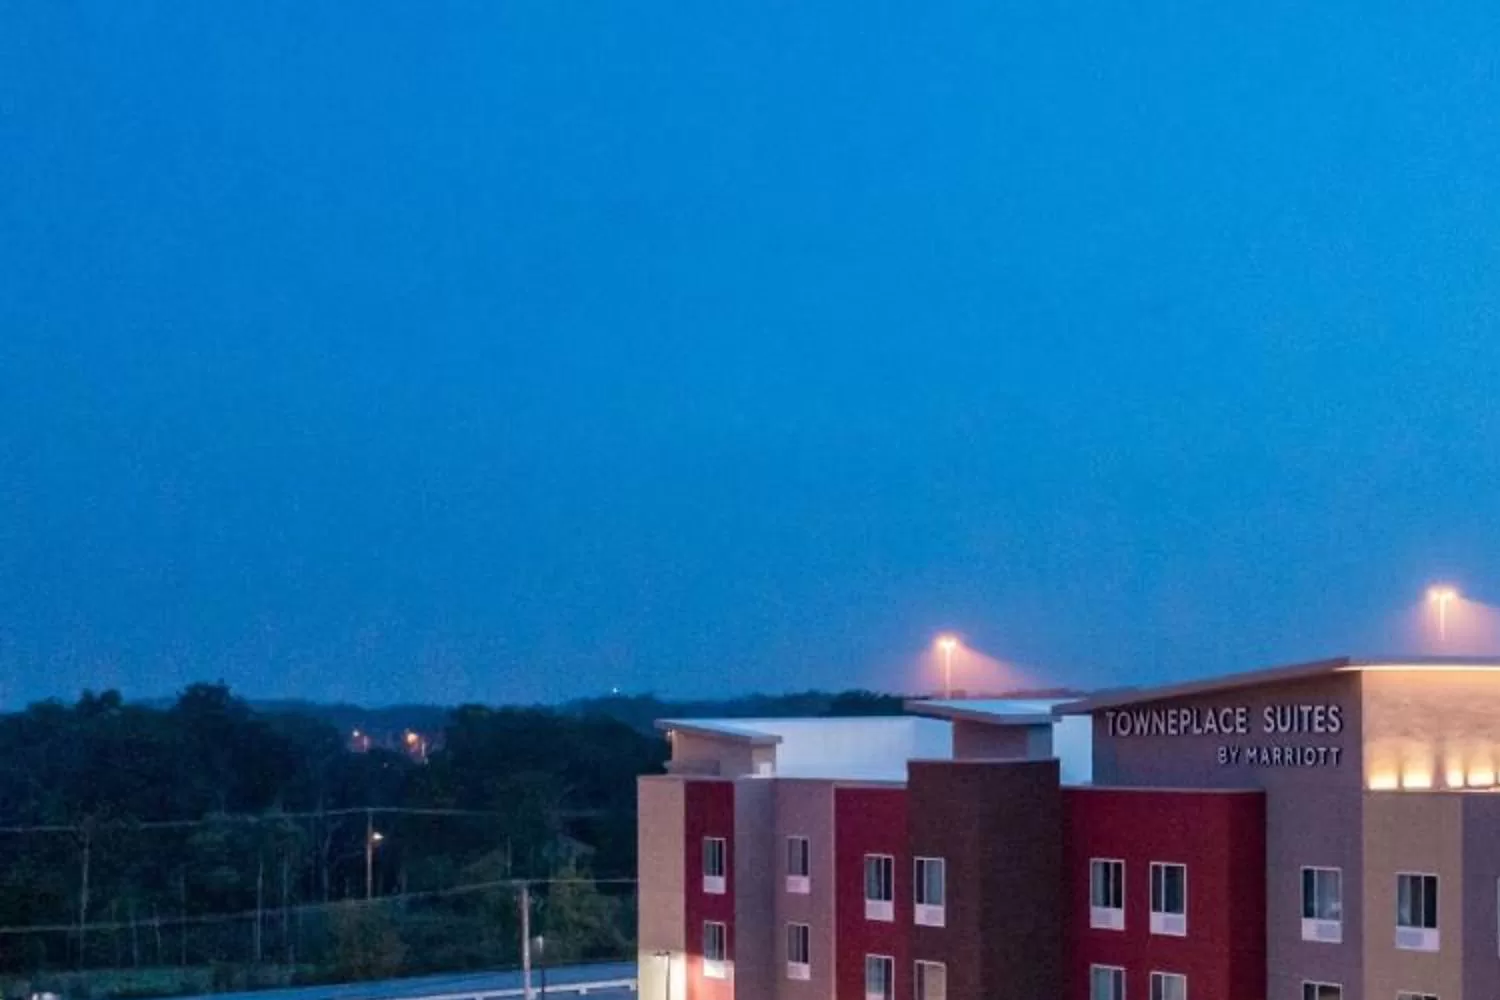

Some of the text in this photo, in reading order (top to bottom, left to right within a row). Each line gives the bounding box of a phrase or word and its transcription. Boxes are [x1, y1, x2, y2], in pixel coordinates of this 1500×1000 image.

[1105, 704, 1342, 737] TOWNEPLACE SUITES
[1217, 747, 1341, 766] BY MARRIOTT
